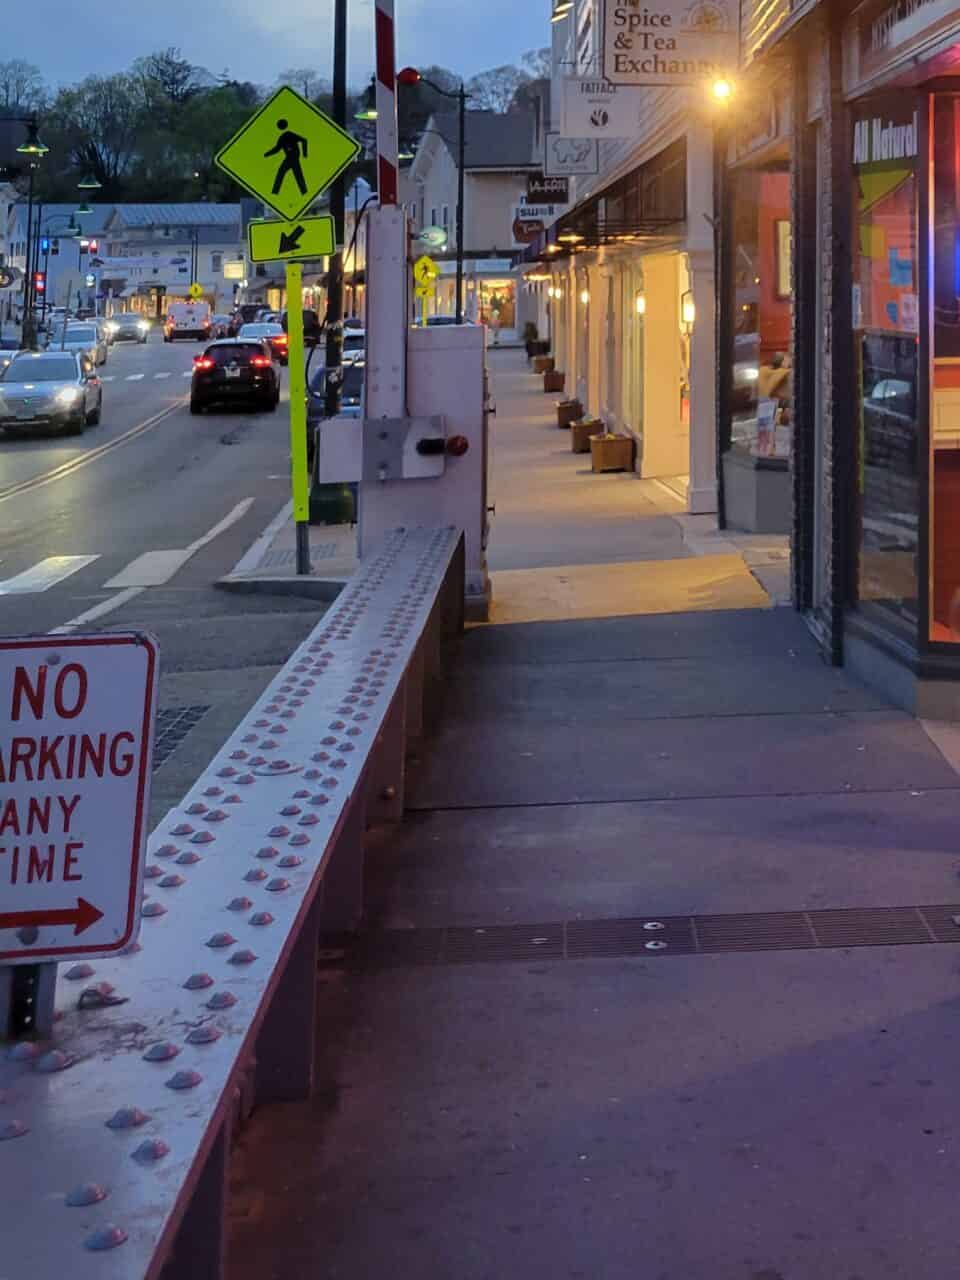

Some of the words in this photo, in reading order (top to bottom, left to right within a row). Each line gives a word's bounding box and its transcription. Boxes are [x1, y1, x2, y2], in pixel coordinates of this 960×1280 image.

[614, 8, 672, 32] Spice
[614, 32, 632, 50] &
[639, 32, 677, 51] Tea
[853, 119, 869, 163] All
[872, 111, 918, 162] Natural
[11, 662, 89, 721] NO
